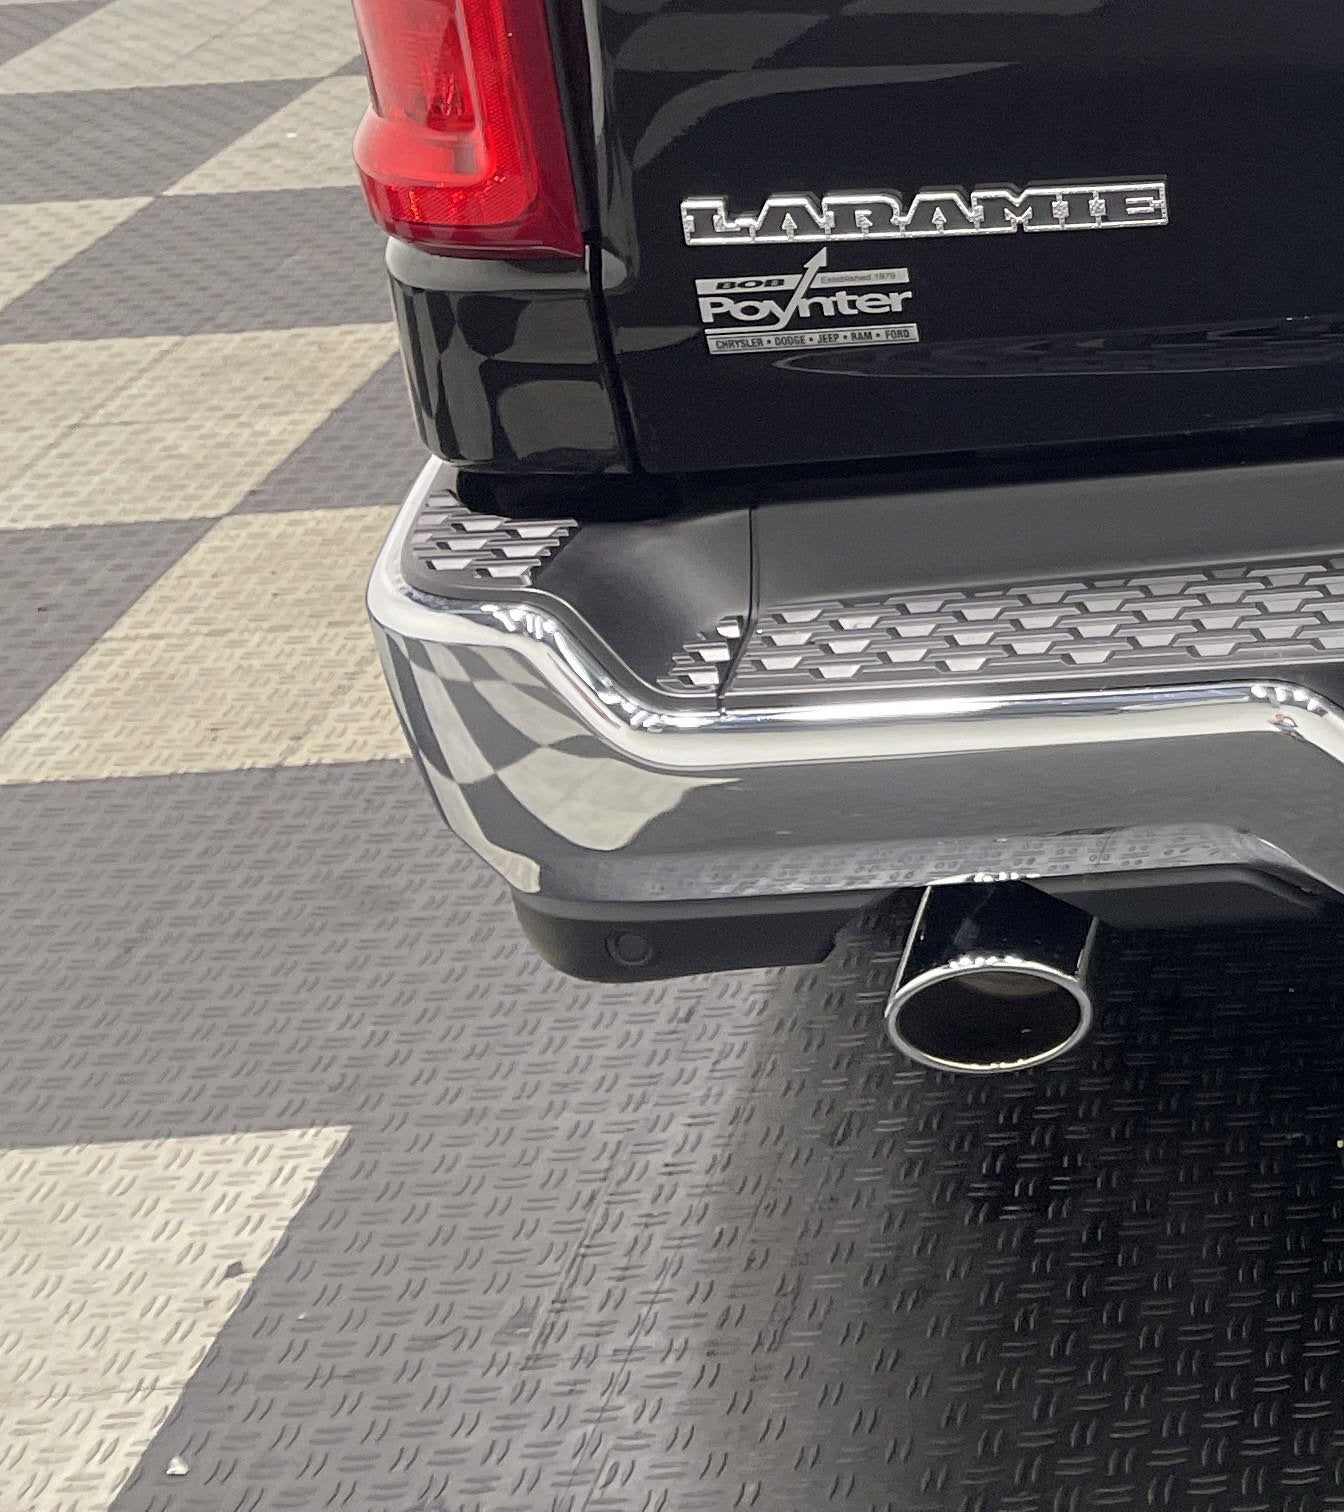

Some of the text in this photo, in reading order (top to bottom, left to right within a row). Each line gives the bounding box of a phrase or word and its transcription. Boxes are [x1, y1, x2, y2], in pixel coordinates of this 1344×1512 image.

[680, 177, 1170, 246] LARAMIE
[715, 278, 785, 290] BOB
[698, 290, 912, 329] Poynter
[715, 328, 910, 350] CHRYSLER DODGE JEEP RAM FORD
